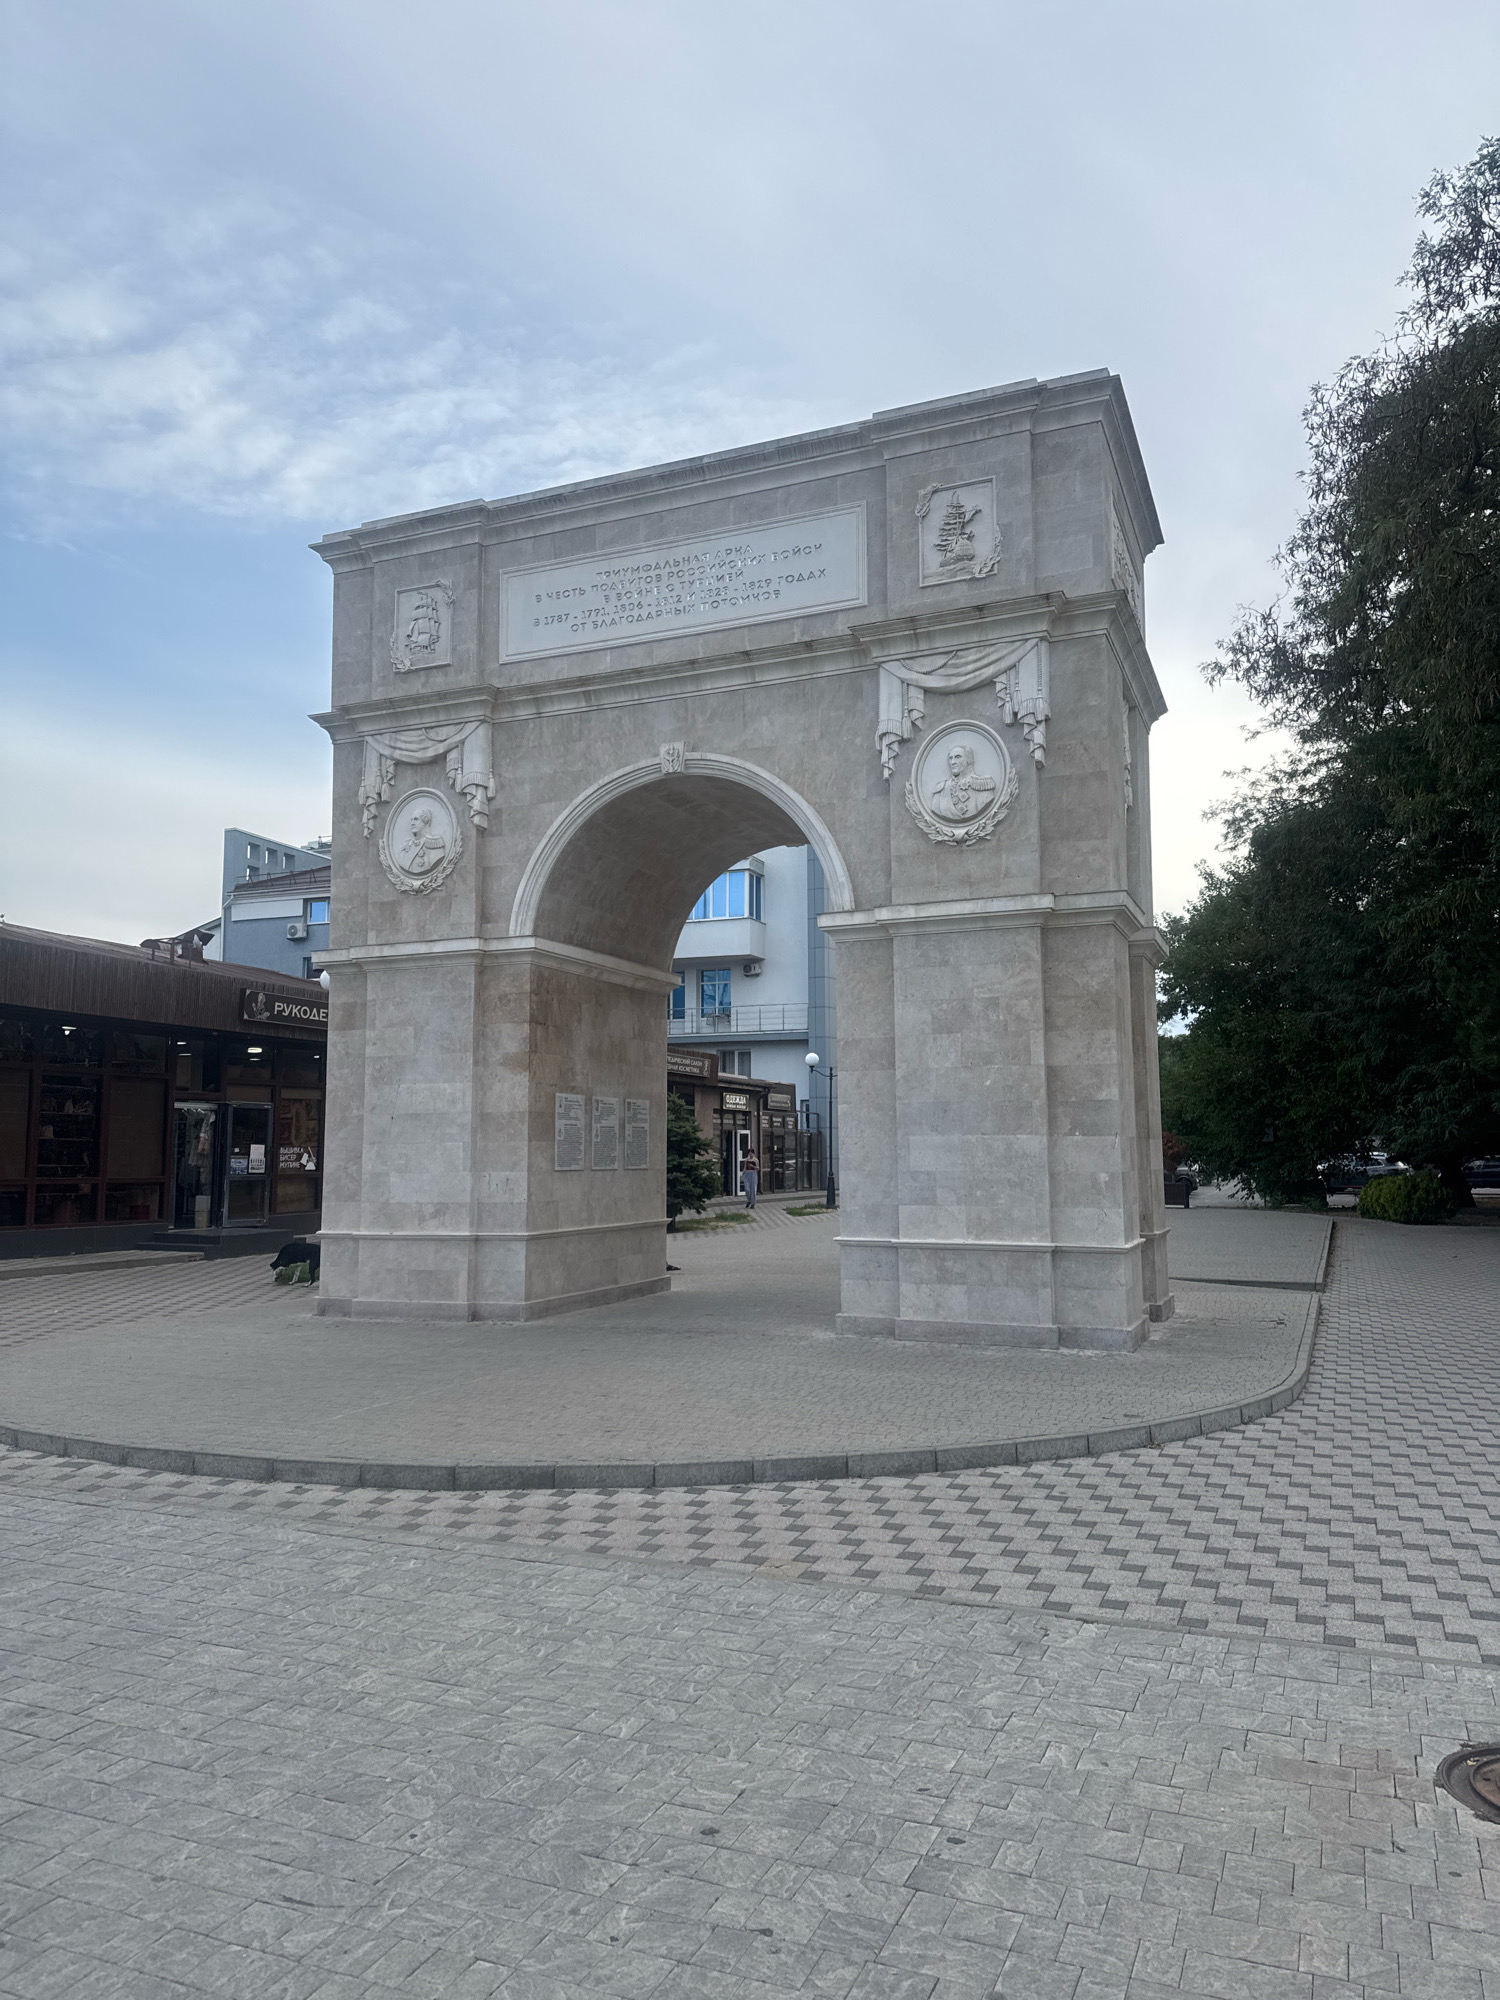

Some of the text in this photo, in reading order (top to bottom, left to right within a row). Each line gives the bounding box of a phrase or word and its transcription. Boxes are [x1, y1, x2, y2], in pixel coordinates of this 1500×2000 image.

[535, 543, 823, 603] В ЧЕСТЬ ПОДВИГОВ РОССИЙСКИХ ВОЙСК
[596, 545, 753, 580] ТРИУМФАЛЬНАЯ АРКА
[603, 569, 744, 603] В ВОЙНЕ С ТУРЦИЕЙ
[686, 591, 696, 601] И
[777, 567, 827, 586] ГОДАХ
[570, 589, 781, 632] ОТ БЛАГОДАРНЫХ ПОТОМКОВ
[274, 1002, 328, 1021] РУКОДЕ
[725, 1094, 746, 1105] ОДЕЖДА
